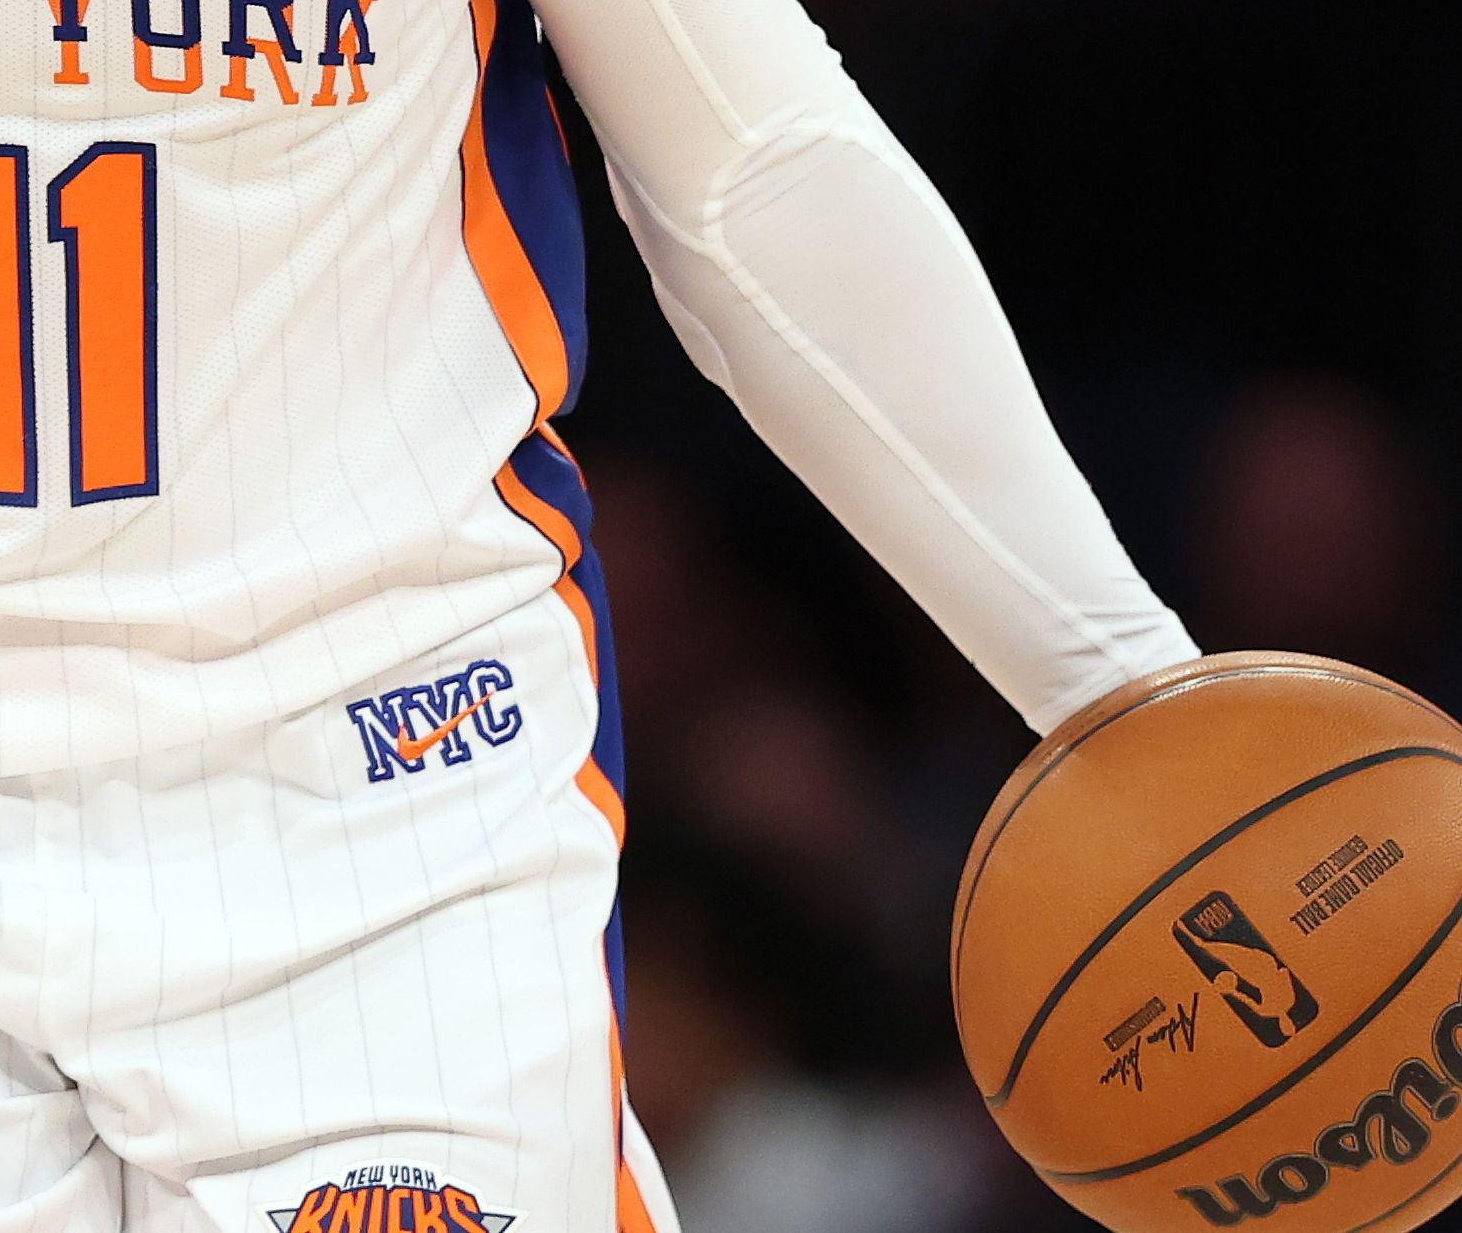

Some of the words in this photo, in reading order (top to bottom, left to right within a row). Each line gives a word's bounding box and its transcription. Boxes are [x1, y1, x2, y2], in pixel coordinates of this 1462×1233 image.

[346, 659, 523, 783] NYC
[1349, 837, 1405, 889] OFFICIAL
[1317, 873, 1361, 914] GAME
[1193, 898, 1233, 936] NBA
[1289, 899, 1329, 937] BALL
[343, 1166, 385, 1188] NEW
[389, 1165, 438, 1189] YORK
